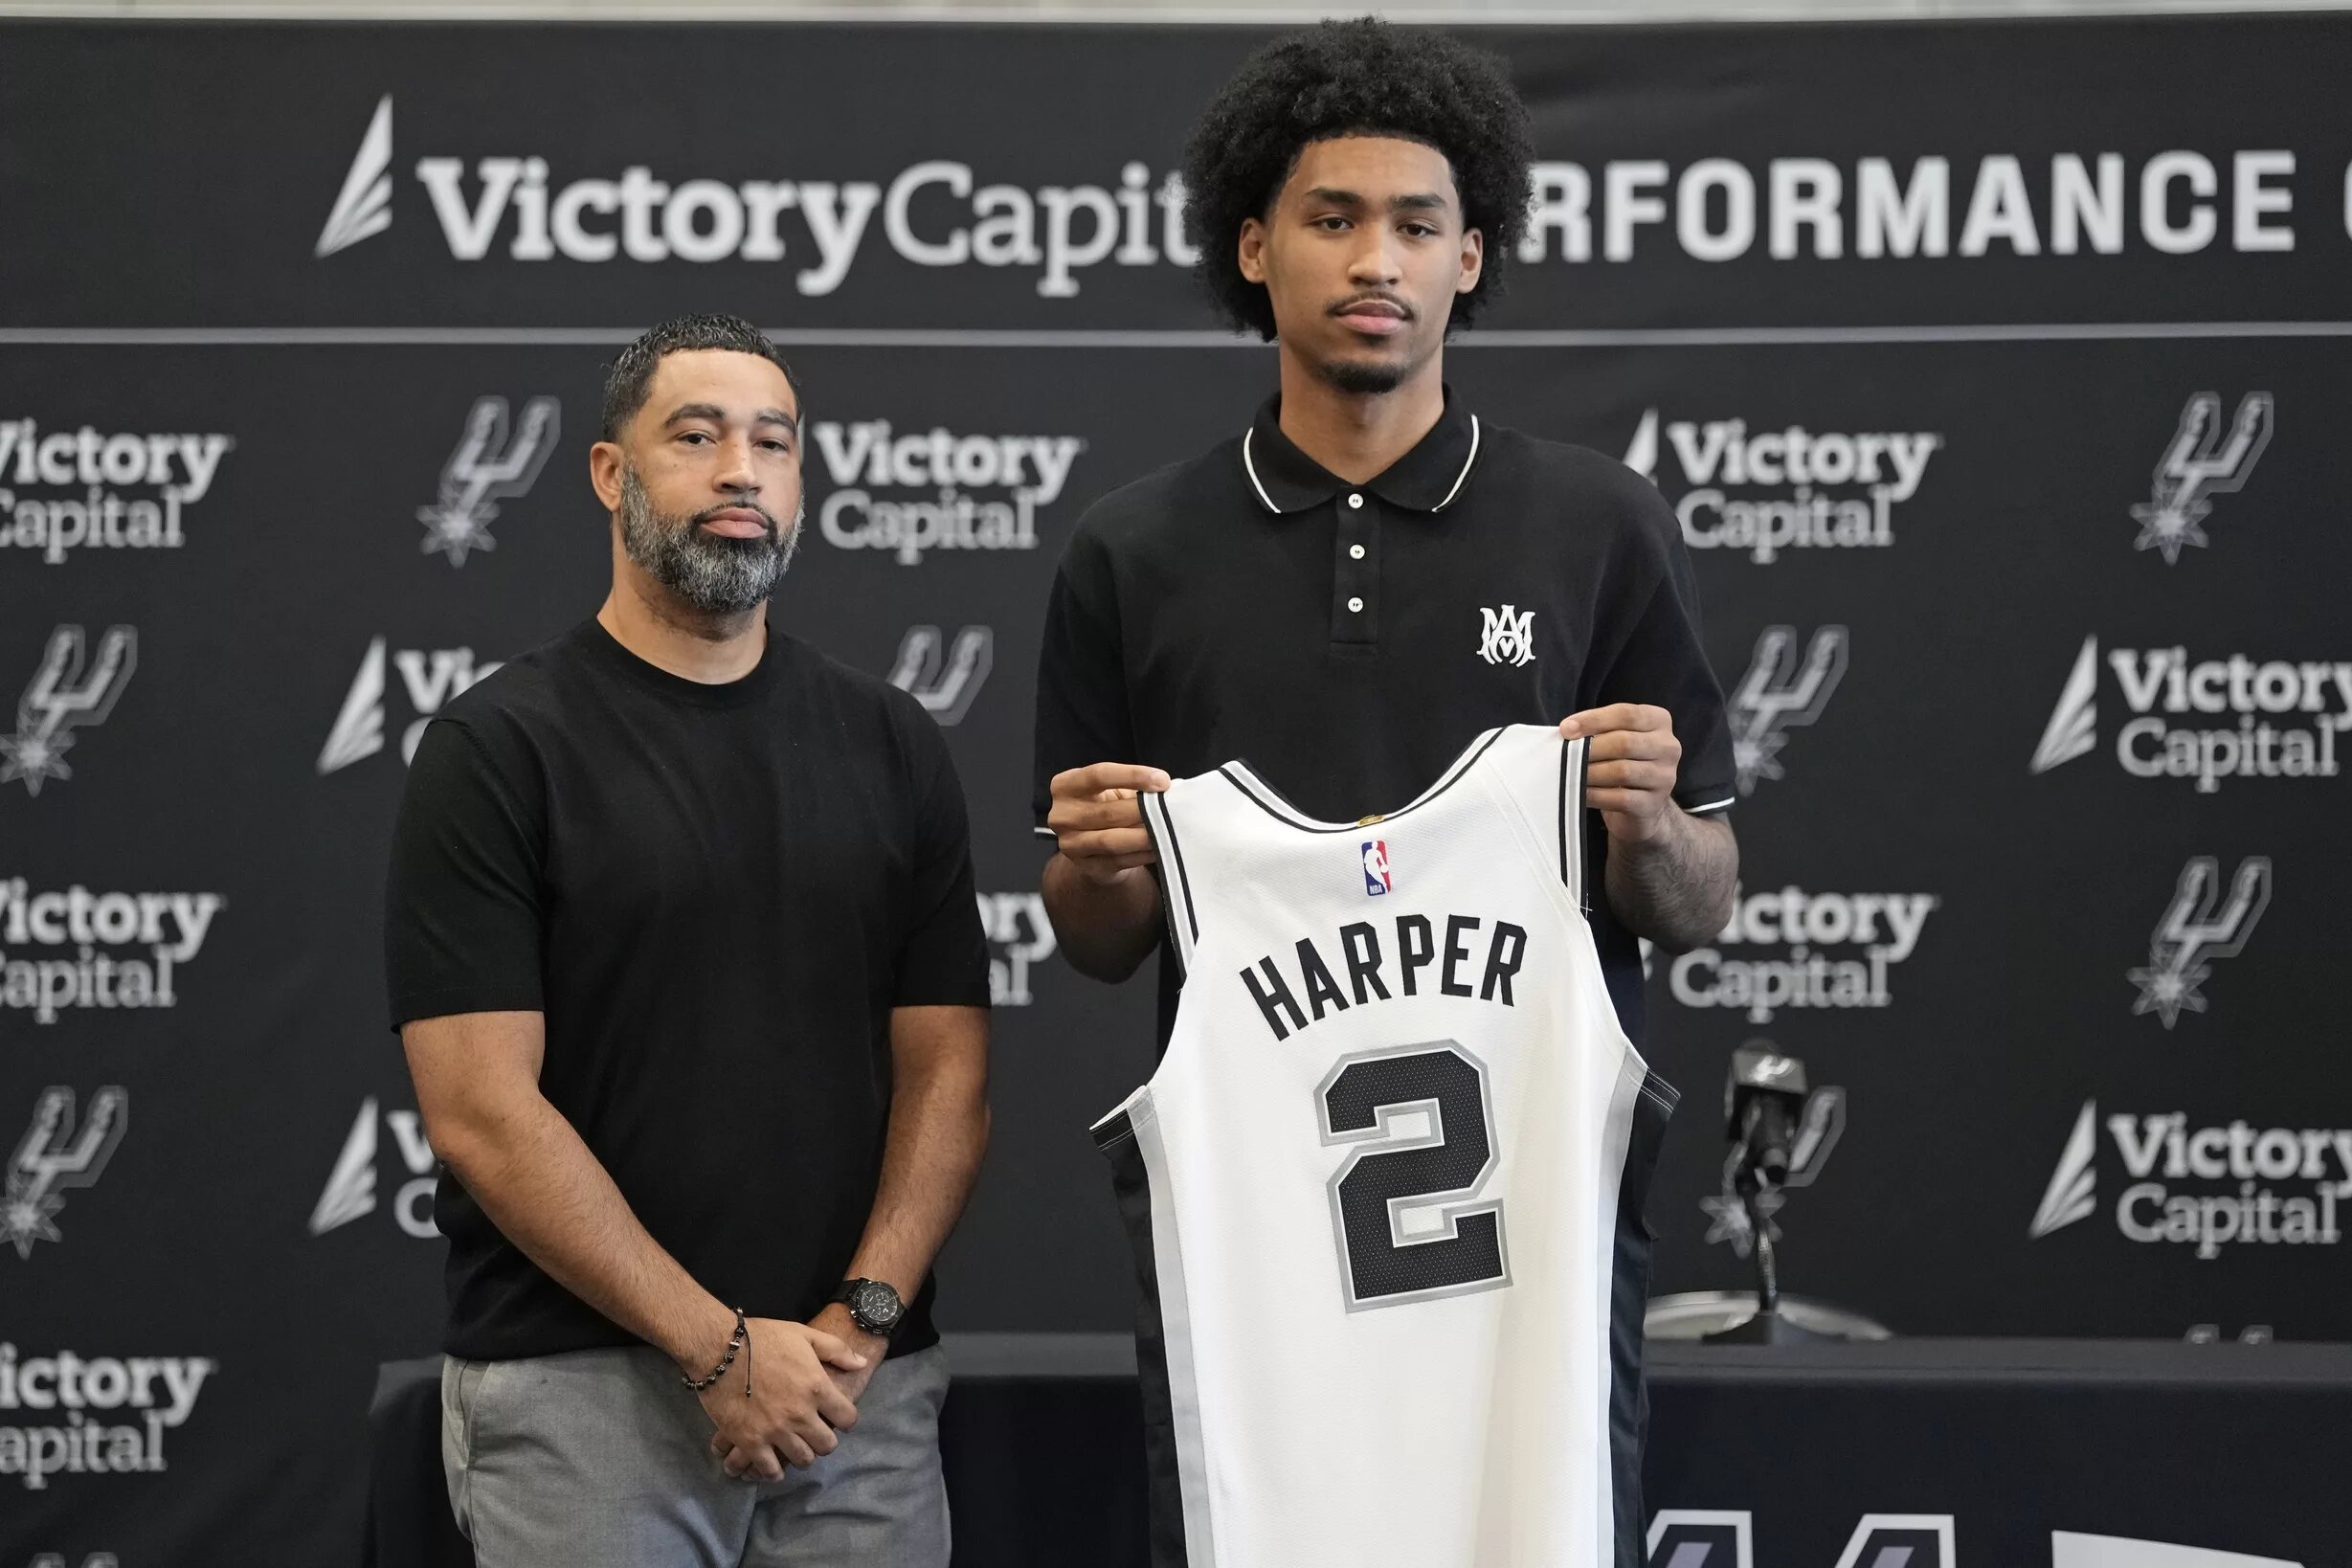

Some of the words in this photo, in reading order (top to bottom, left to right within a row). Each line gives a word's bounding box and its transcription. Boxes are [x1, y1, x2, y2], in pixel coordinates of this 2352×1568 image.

[1501, 149, 2296, 263] RFORMANCE
[813, 419, 1084, 505] Victory
[1667, 417, 1939, 503] Victory
[819, 486, 1039, 565] Capital
[1676, 485, 1894, 565] Capital
[2117, 713, 2340, 794] Capital
[0, 876, 223, 963] ictory
[1369, 885, 1383, 895] NBA
[0, 944, 178, 1024] apital
[1240, 914, 1528, 1042] HARPER
[1669, 945, 1893, 1024] Capital
[1313, 1039, 1513, 1314] 2
[2116, 1180, 2341, 1260] Capital
